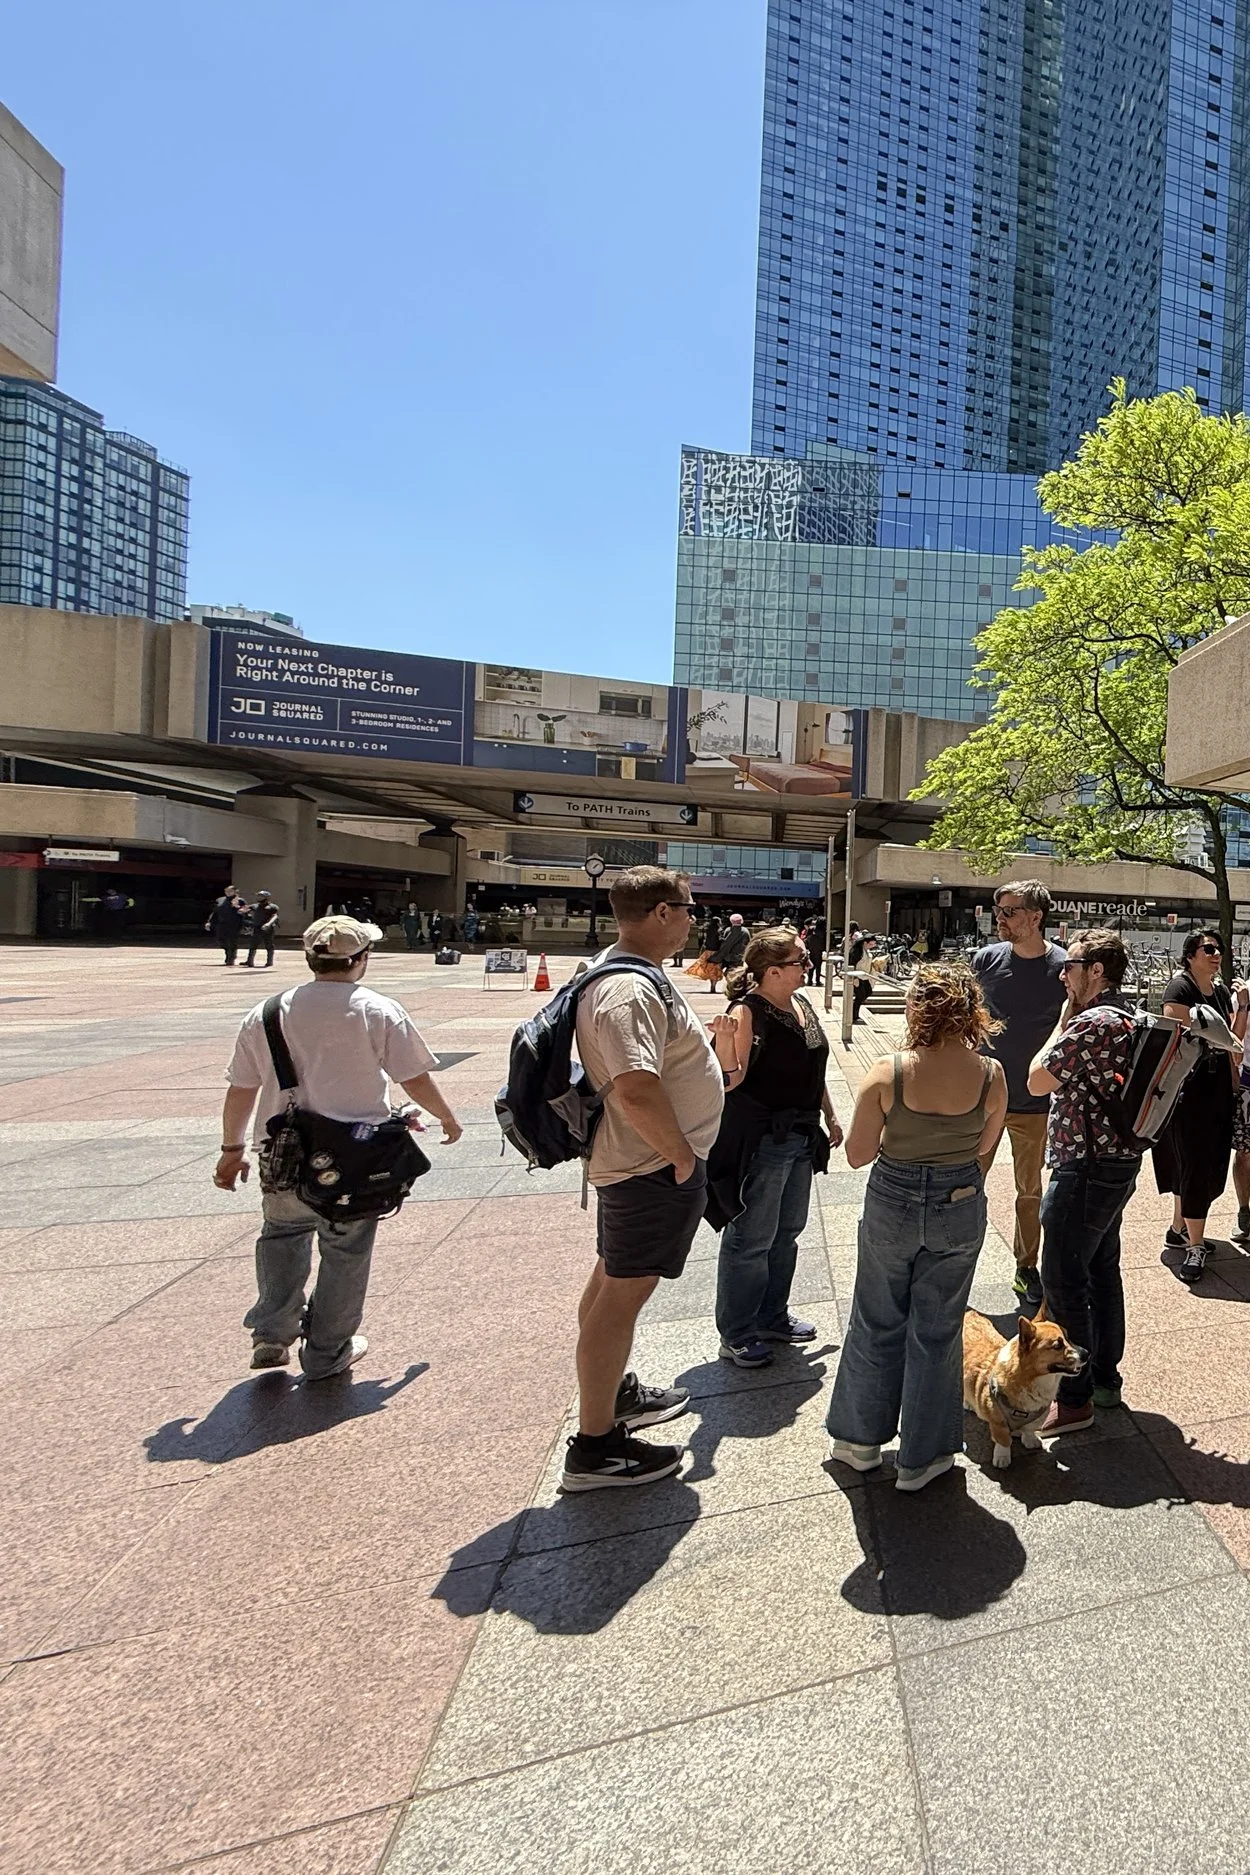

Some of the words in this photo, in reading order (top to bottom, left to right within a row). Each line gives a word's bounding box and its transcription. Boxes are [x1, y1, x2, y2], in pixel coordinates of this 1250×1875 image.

[237, 641, 264, 651] NOW
[269, 645, 320, 658] LEASING
[236, 653, 274, 669] Your
[278, 658, 314, 673] Next
[318, 663, 378, 681] Chapter
[381, 670, 394, 682] is
[236, 666, 278, 682] Right
[282, 672, 338, 688] Around
[342, 678, 367, 691] the
[370, 682, 420, 696] Corner
[272, 701, 324, 714] JOURNAL
[272, 709, 324, 721] SQUARED
[351, 710, 388, 720] STUNNING
[389, 714, 416, 723] STUDIO,
[351, 718, 394, 729] 3-BEDROOM
[396, 723, 440, 733] RESIDENCES
[229, 731, 388, 751] JOURNALSQUARED.COM
[566, 801, 580, 812] To
[583, 803, 613, 815] PATH
[618, 806, 651, 817] Trains
[1050, 900, 1097, 914] DUANE
[1098, 899, 1148, 917] reade
